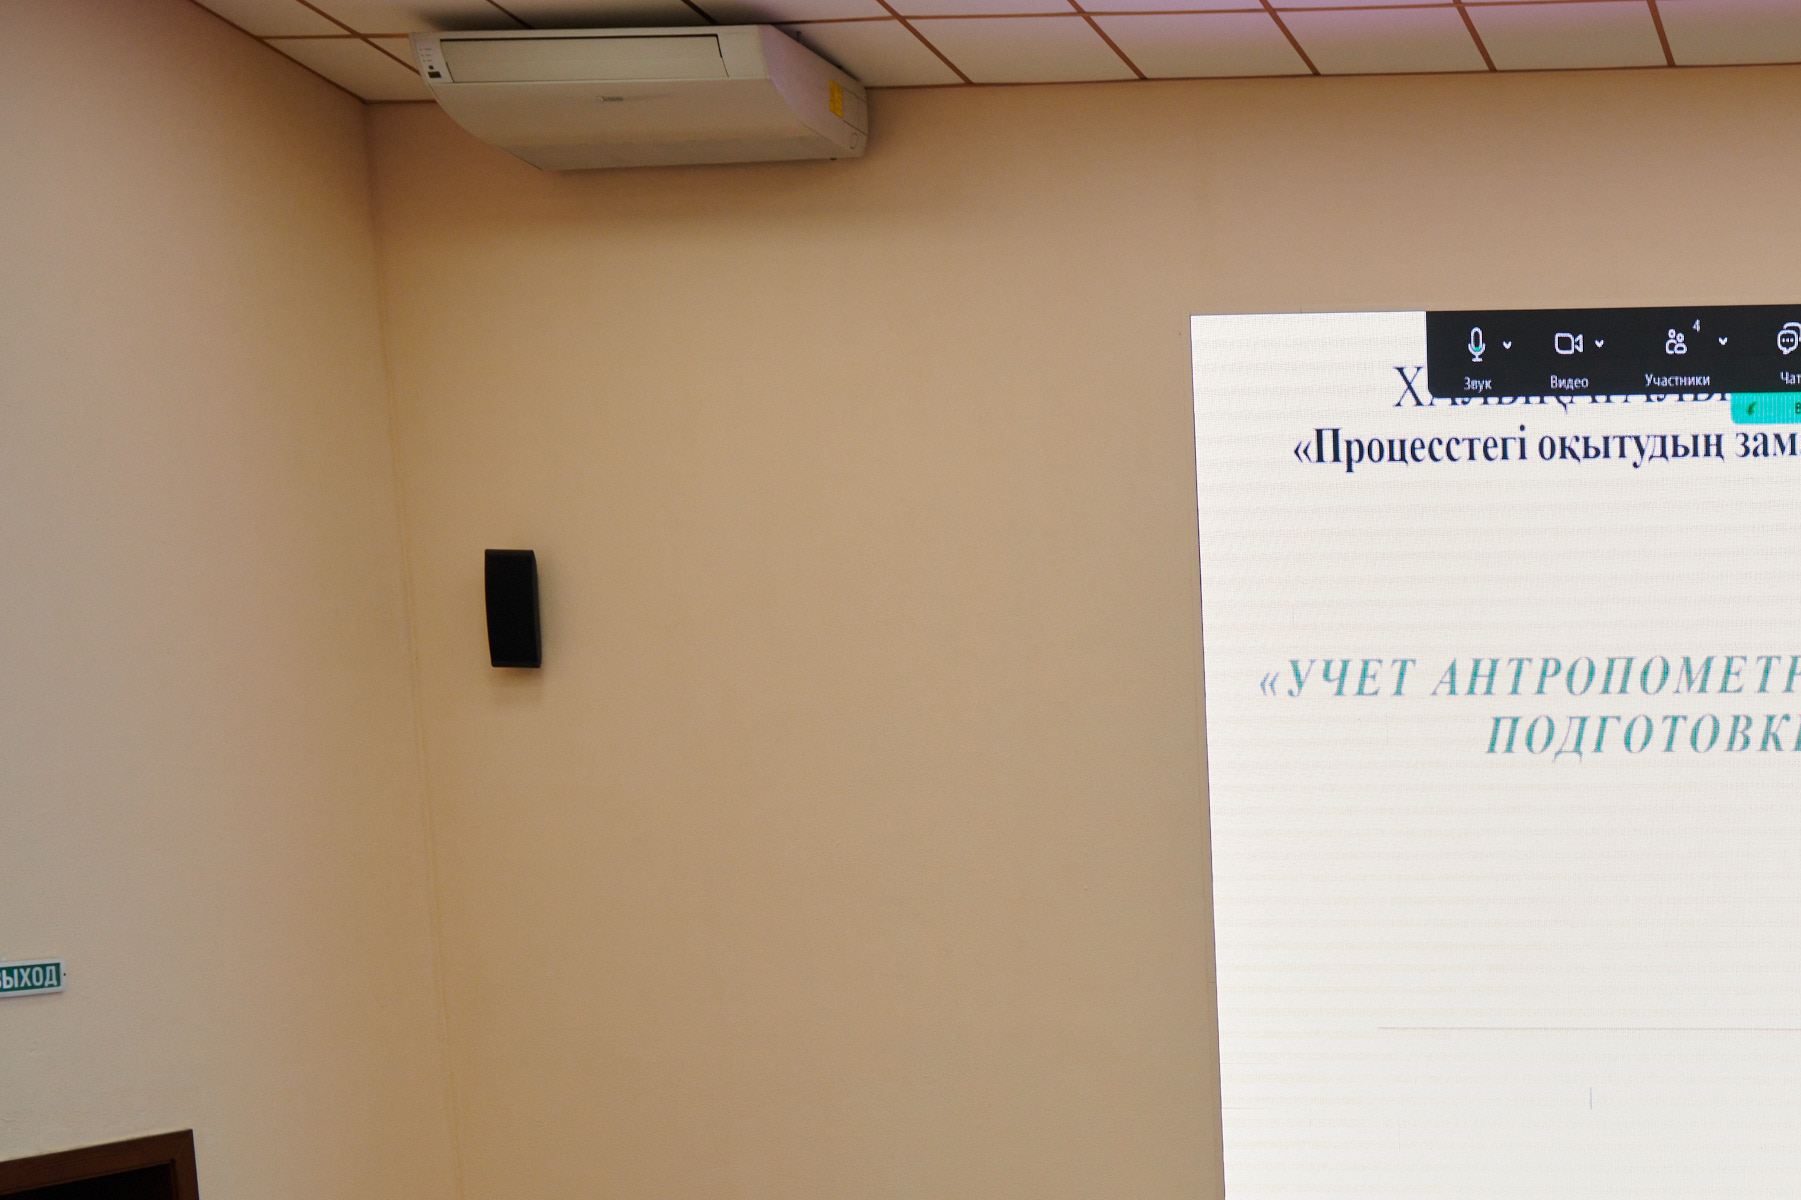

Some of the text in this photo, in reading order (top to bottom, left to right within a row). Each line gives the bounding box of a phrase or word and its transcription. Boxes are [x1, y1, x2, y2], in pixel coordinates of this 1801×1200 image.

[1464, 376, 1493, 392] Звук
[1550, 375, 1589, 391] Видео
[1644, 373, 1711, 389] Участники
[1780, 371, 1801, 387] Чат
[1294, 425, 1528, 474] «Процесстегі
[1538, 430, 1725, 469] оқытудың
[1260, 657, 1417, 698] «УЧЕТ
[0, 965, 58, 989] ЫХОД
